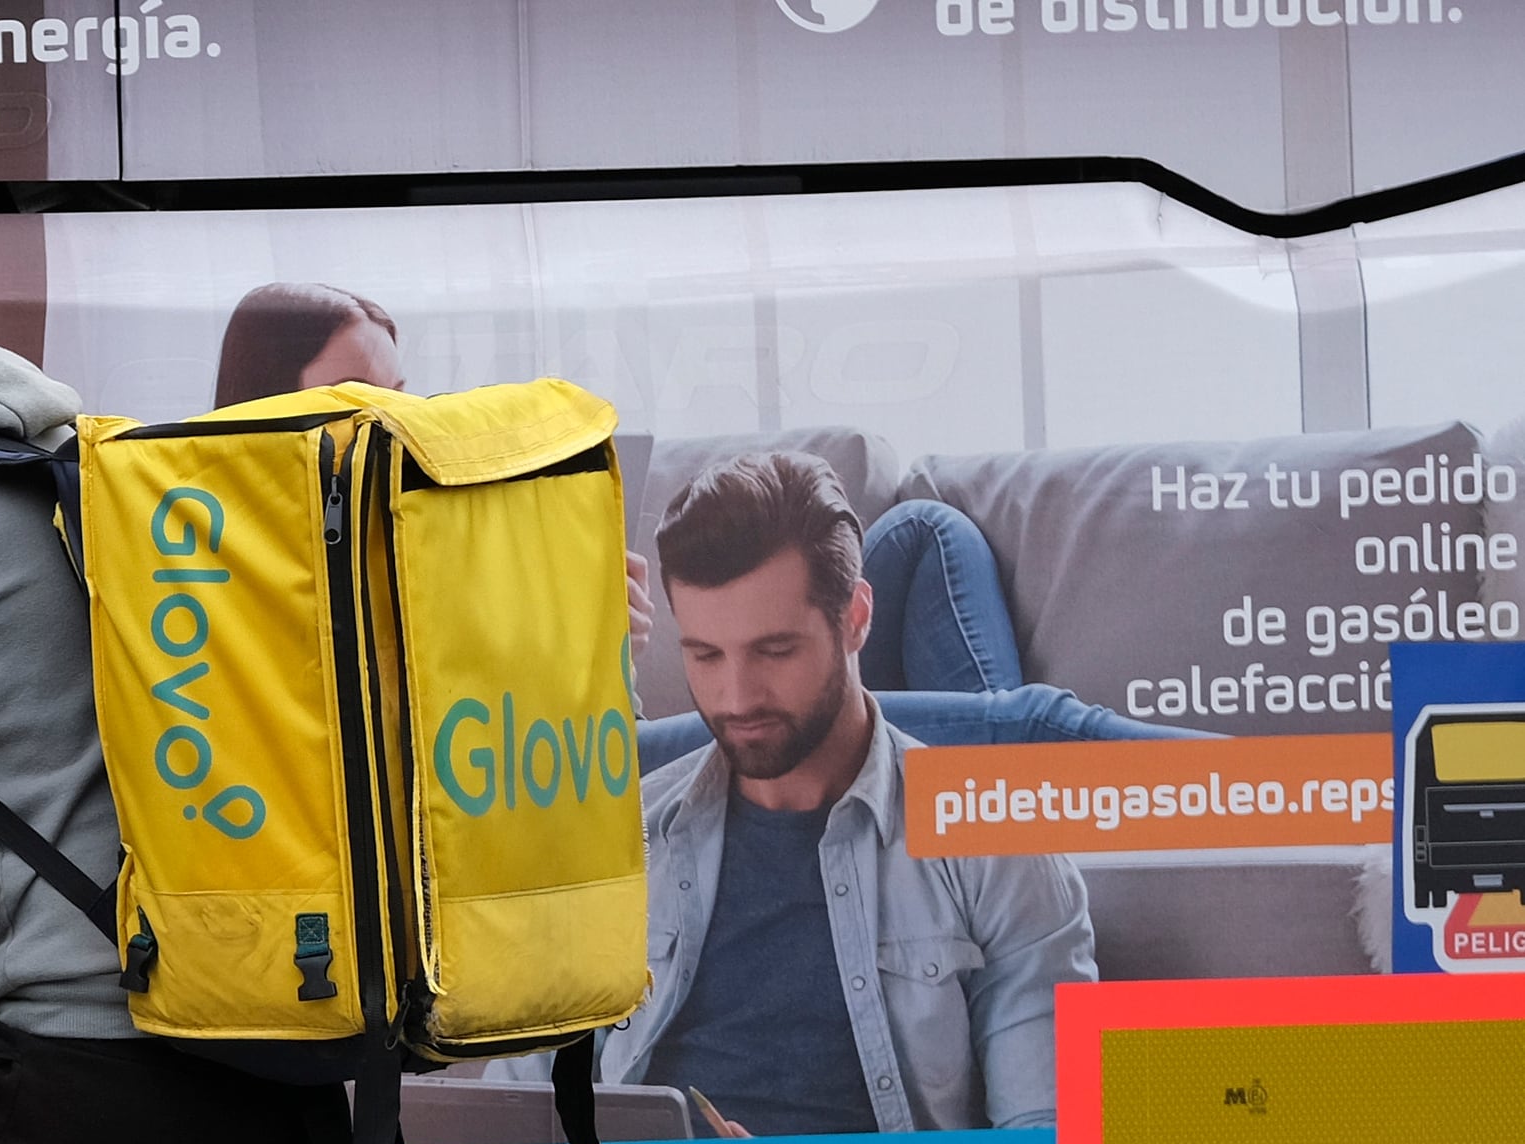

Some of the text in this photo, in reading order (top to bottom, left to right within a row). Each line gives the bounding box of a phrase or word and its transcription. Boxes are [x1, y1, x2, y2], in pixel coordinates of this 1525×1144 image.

[1151, 453, 1517, 520] Haz tu pedido
[1355, 522, 1517, 575] online
[150, 485, 231, 790] Glovo
[1222, 588, 1520, 656] de gasóleo
[433, 690, 632, 817] Glovo
